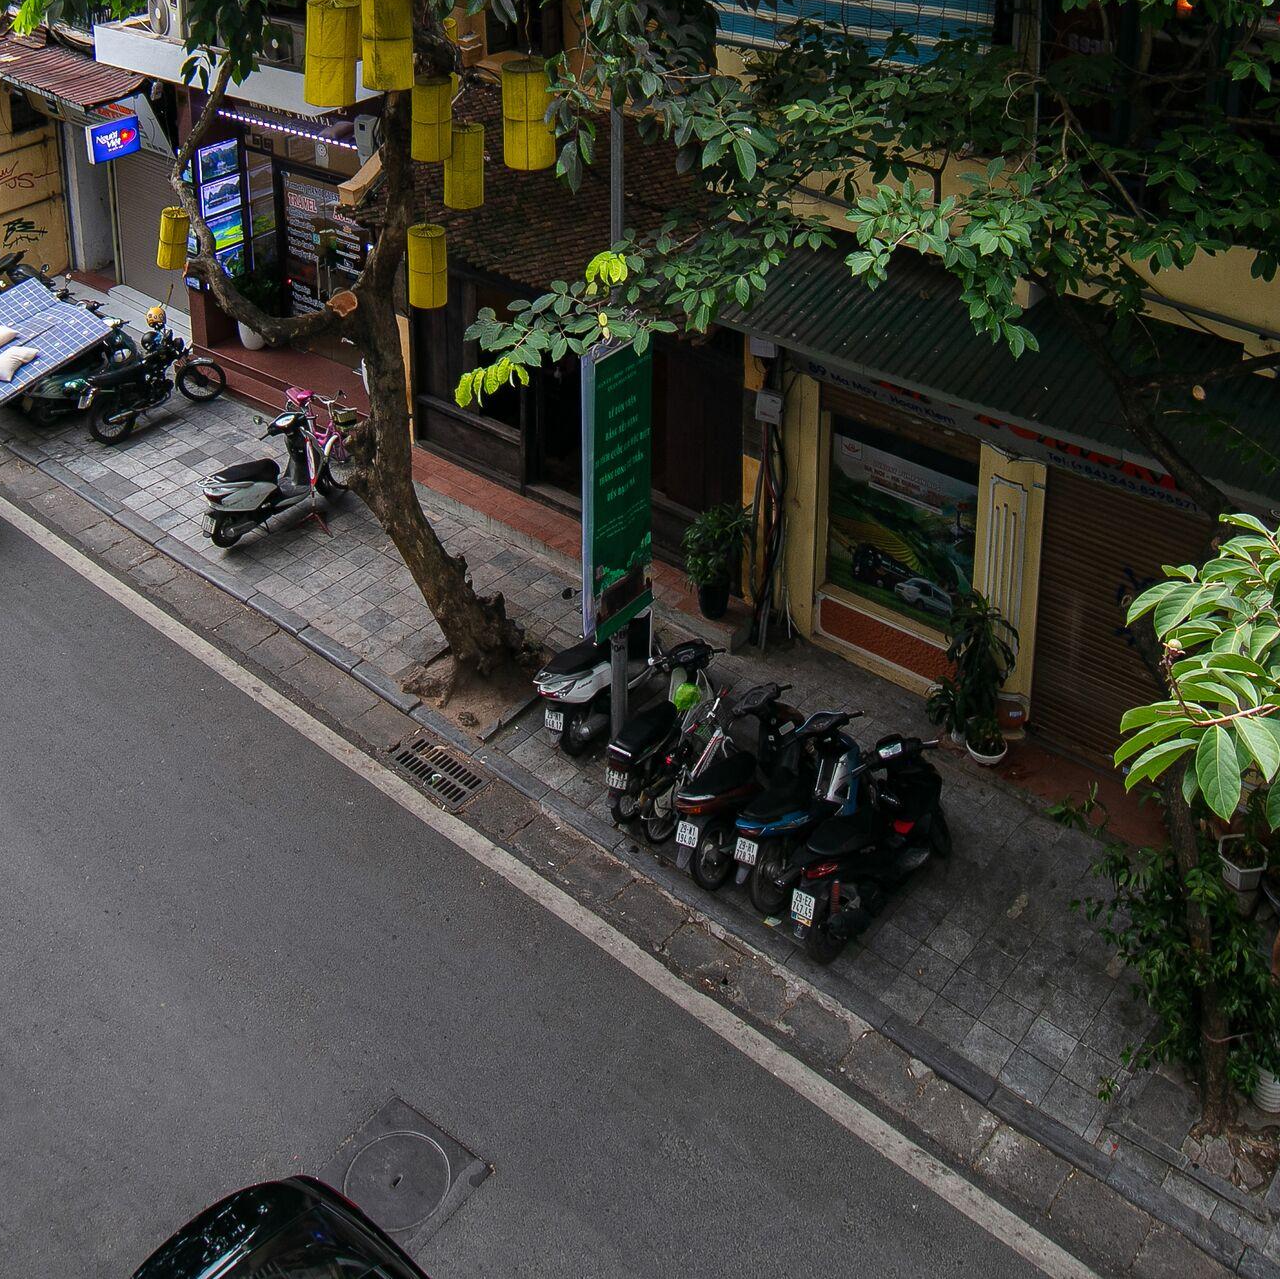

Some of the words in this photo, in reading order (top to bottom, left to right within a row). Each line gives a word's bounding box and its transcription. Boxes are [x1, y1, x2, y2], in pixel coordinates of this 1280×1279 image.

[296, 113, 333, 128] TRAVEL
[287, 191, 318, 214] TRAVEL
[851, 380, 879, 398] May
[794, 891, 813, 907] 29-E2
[792, 900, 813, 919] 747.45
